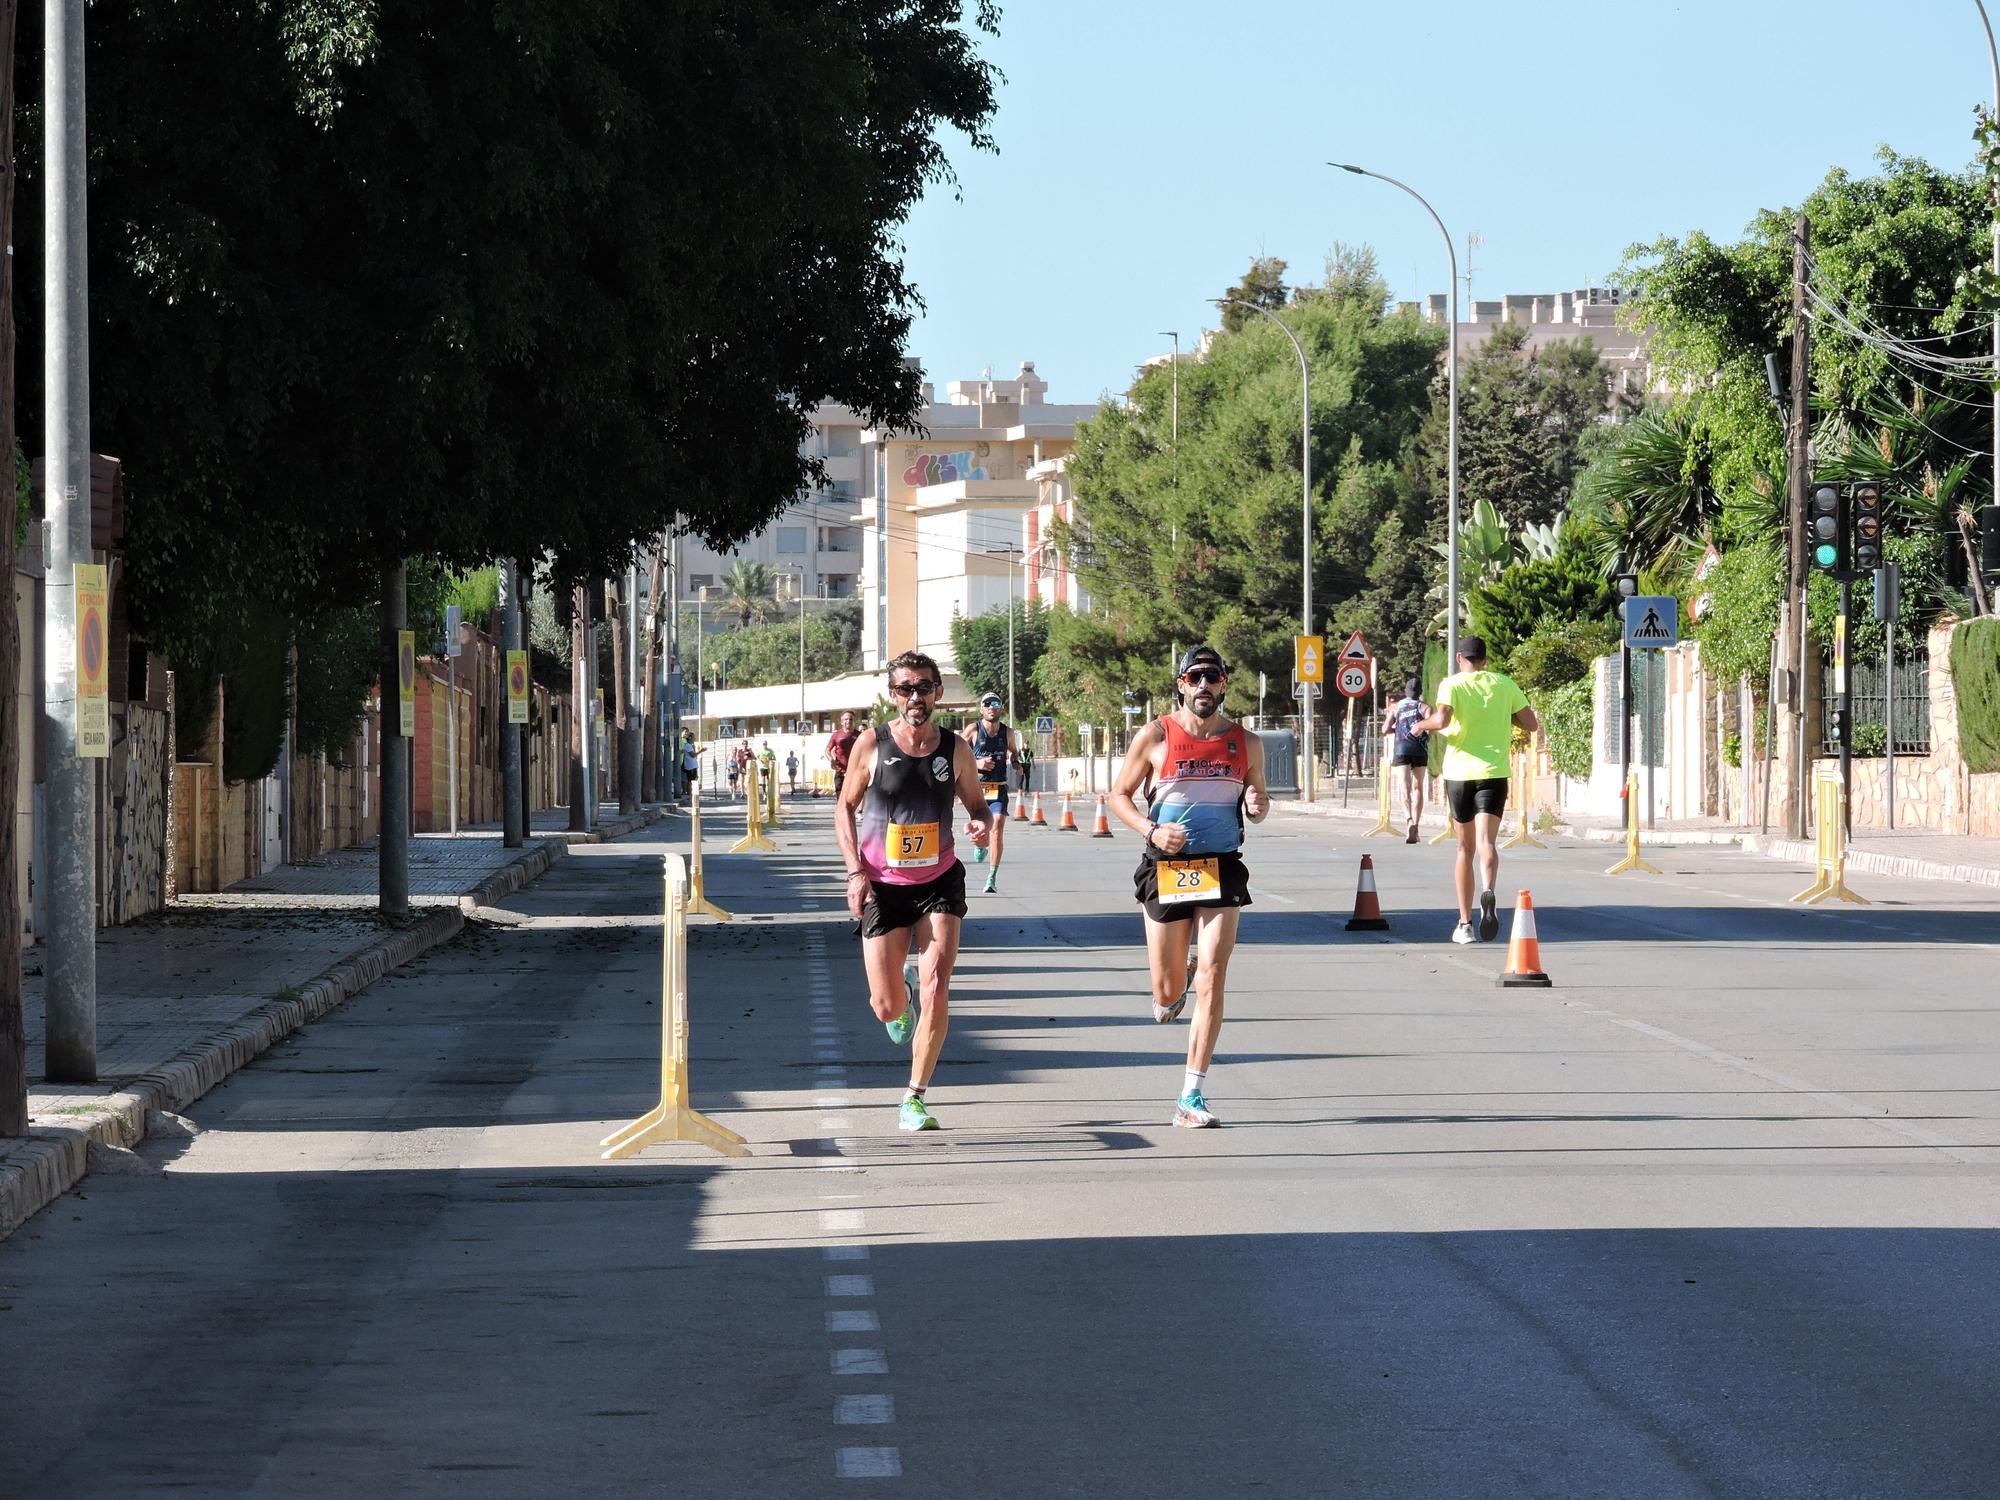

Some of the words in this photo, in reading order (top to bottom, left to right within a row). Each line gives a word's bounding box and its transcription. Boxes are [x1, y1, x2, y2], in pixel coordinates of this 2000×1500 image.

[1345, 675, 1362, 686] 30
[902, 836, 924, 854] 57
[1177, 871, 1201, 888] 28
